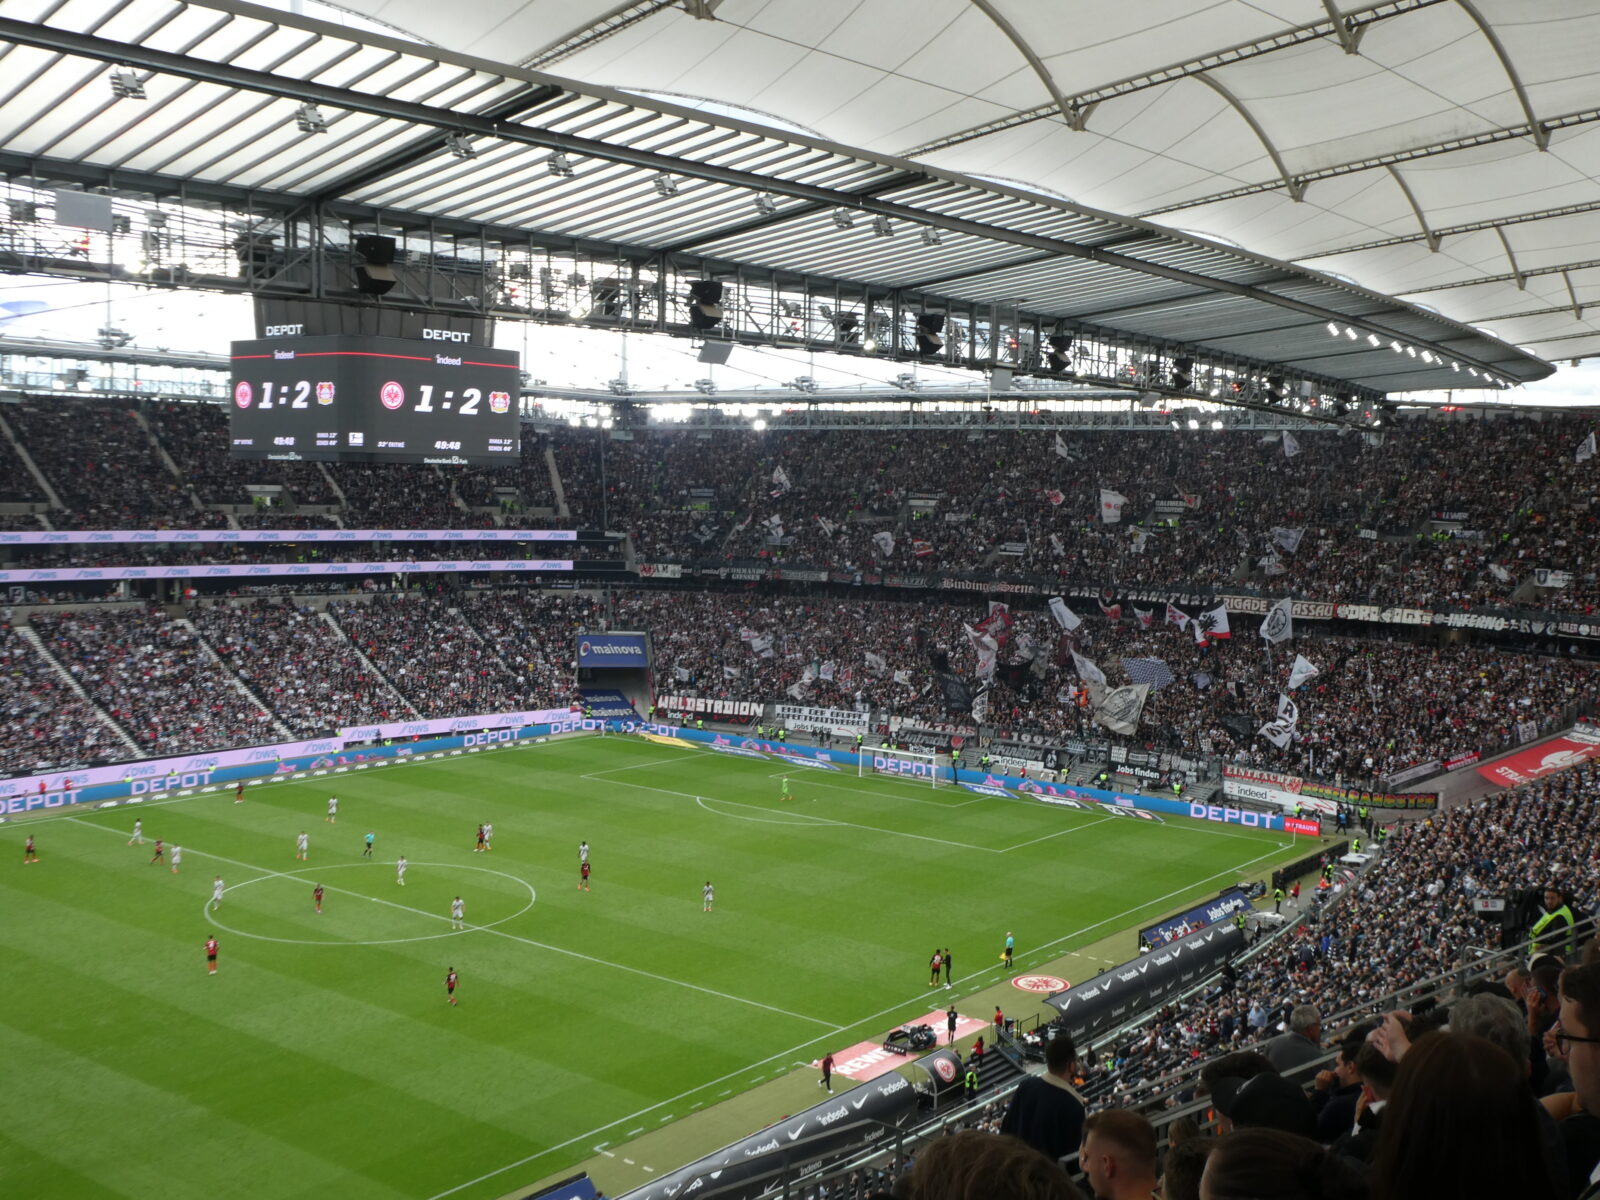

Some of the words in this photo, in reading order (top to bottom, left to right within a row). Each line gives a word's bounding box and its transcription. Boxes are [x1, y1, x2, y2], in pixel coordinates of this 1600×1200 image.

[265, 324, 303, 336] DEPOT
[423, 328, 471, 343] DEPOT
[436, 354, 462, 366] indeed
[997, 581, 1034, 594] Szene
[1041, 584, 1099, 598] ULTRAS
[1292, 603, 1333, 616] ASSAU
[592, 643, 642, 655] mainova
[657, 695, 765, 717] WALDSTADION
[505, 715, 525, 724] DWS
[552, 712, 570, 721] DWS
[408, 724, 429, 734] DWS
[458, 720, 477, 729] DWS
[550, 719, 606, 735] DEPOT
[793, 723, 810, 731] Jobs
[359, 729, 379, 739] DWS
[464, 728, 523, 747] DEPOT
[312, 742, 332, 751] DWS
[255, 750, 278, 760] DWS
[195, 757, 219, 767] DWS
[874, 756, 940, 778] DEPOT
[1000, 756, 1028, 768] indeed
[132, 765, 157, 777] DWS
[1116, 765, 1134, 775] Jobs
[1134, 767, 1160, 780] finden
[1226, 767, 1299, 784] EINTRACHT
[130, 771, 214, 796] DEPOT
[1237, 785, 1268, 800] indeed
[1190, 803, 1277, 829] DEPOT
[1207, 906, 1225, 921] Jobs
[1219, 898, 1245, 915] finden
[878, 1076, 909, 1097] indeed
[816, 1105, 850, 1126] indeed
